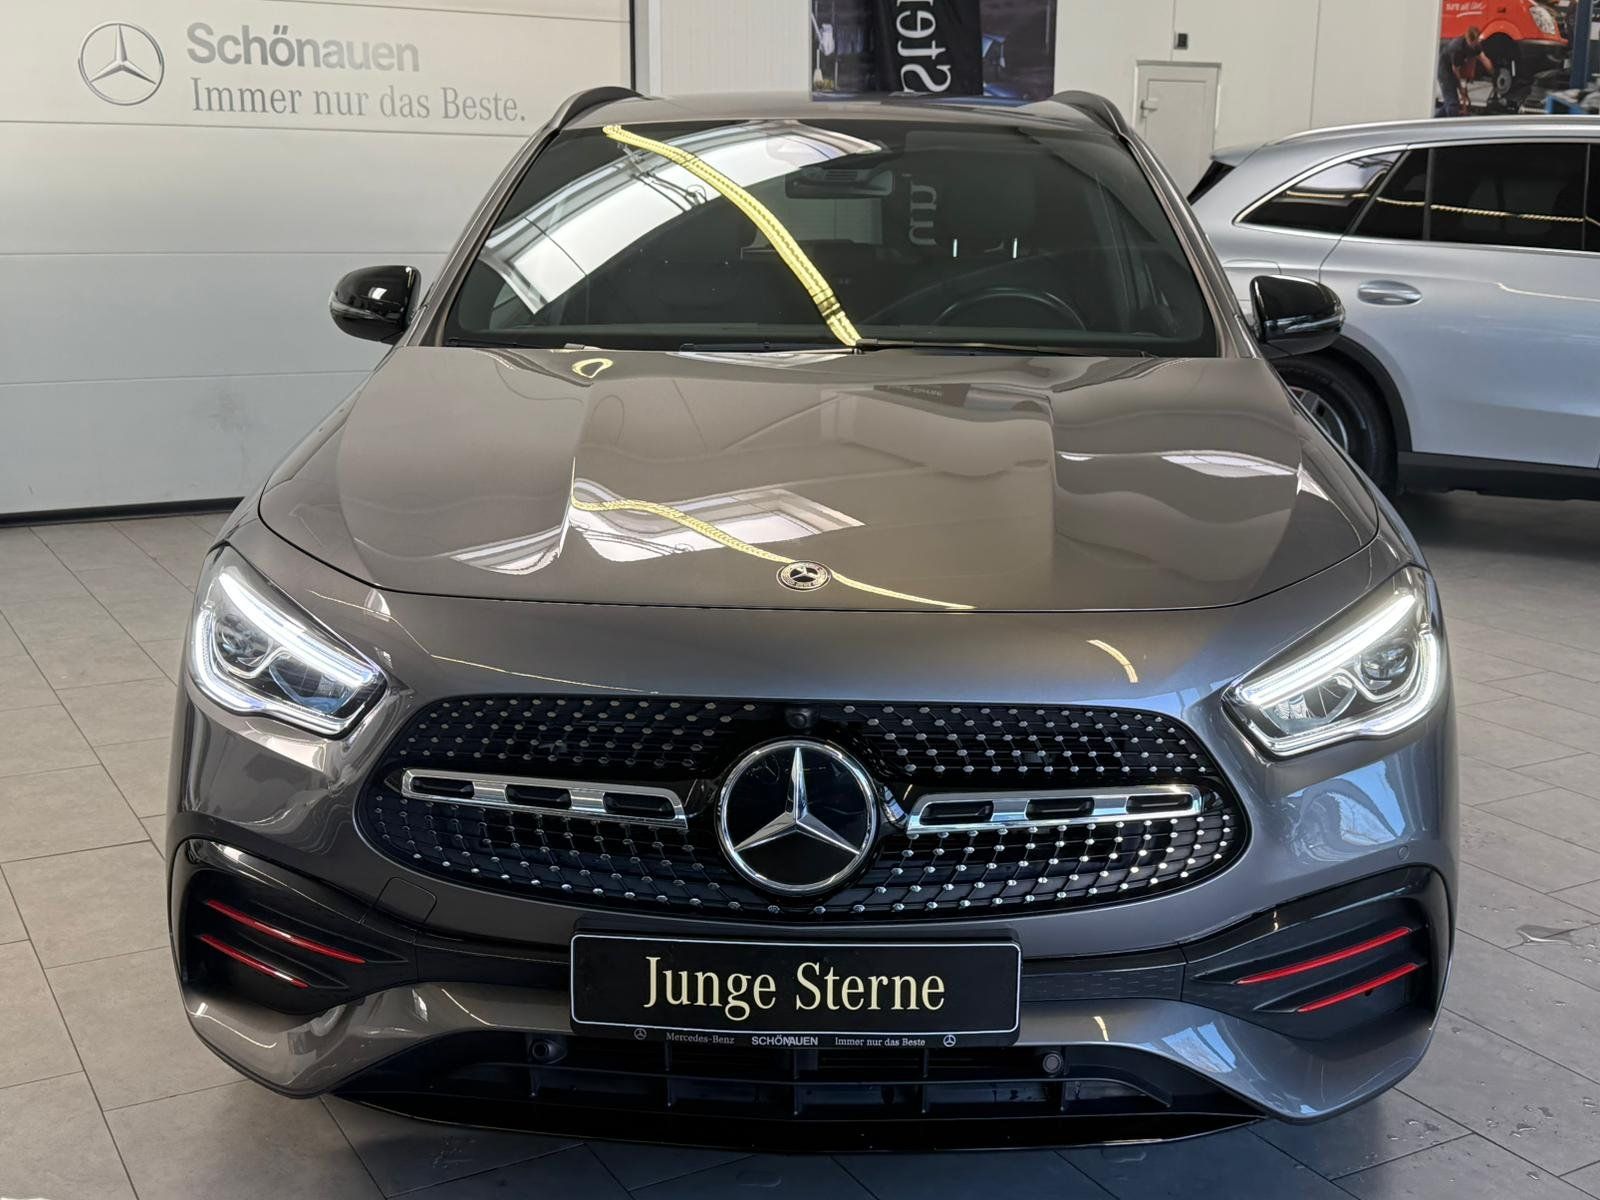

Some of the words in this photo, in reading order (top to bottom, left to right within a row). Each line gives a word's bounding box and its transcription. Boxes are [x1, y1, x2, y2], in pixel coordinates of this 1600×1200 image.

[187, 22, 419, 72] Schönauen
[190, 77, 302, 114] Immer
[313, 91, 369, 116] nur
[380, 85, 430, 119] das
[440, 87, 525, 122] Beste.
[643, 957, 776, 1021] Junge
[795, 962, 945, 1011] Sterne
[666, 1032, 735, 1044] Mercedes-Benz
[751, 1035, 818, 1046] SCHÖNAUEN
[835, 1036, 864, 1046] Immer
[866, 1037, 882, 1046] nur
[884, 1037, 900, 1046] das
[902, 1037, 926, 1047] Beste
